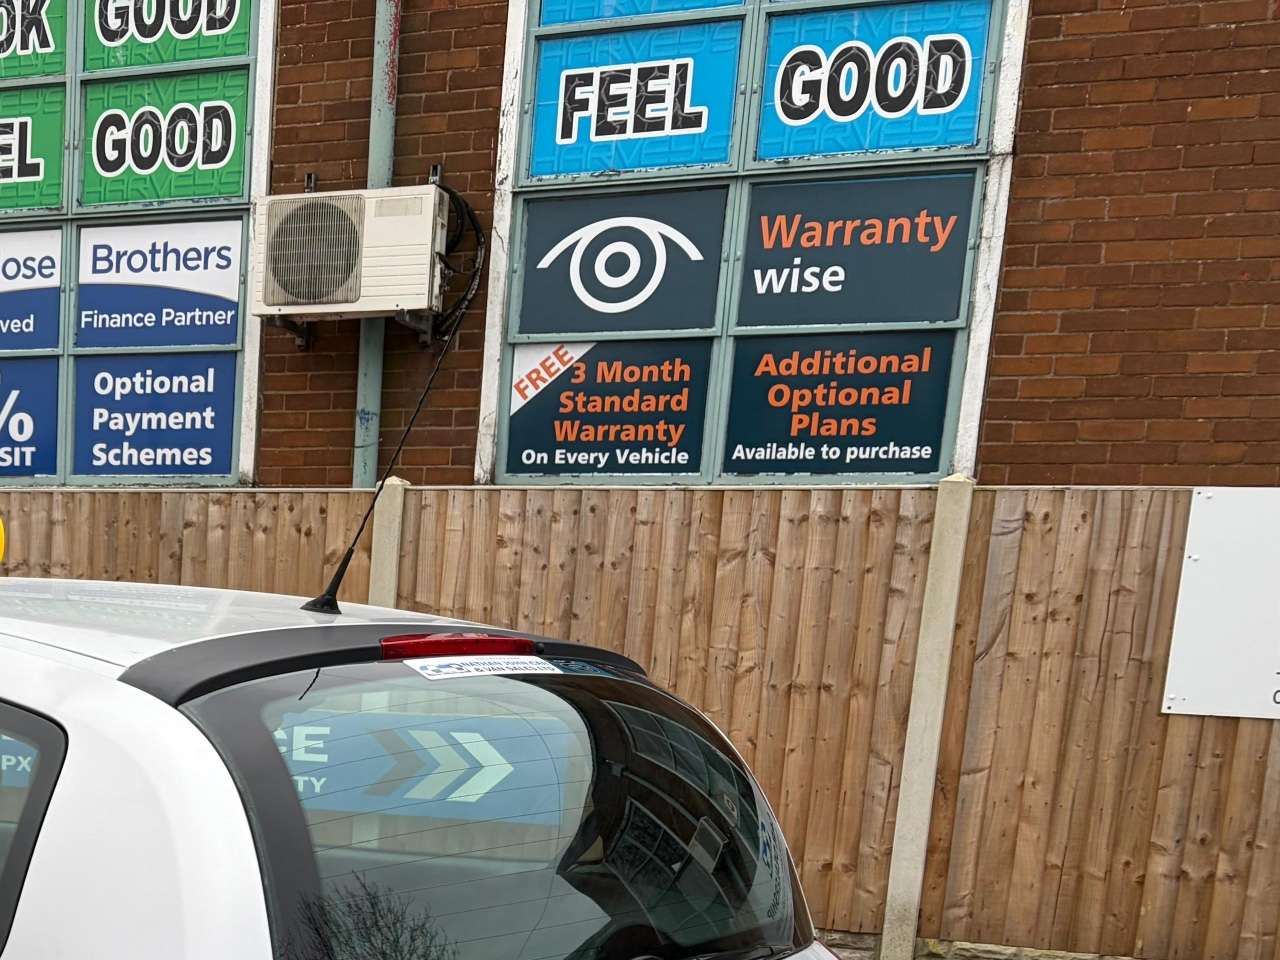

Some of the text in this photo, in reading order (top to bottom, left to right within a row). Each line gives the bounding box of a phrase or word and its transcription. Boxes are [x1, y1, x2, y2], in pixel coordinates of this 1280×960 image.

[95, 0, 238, 47] GOOD
[556, 33, 972, 144] FEEL GOOD
[93, 101, 236, 177] GOOD
[760, 208, 958, 253] Warranty
[91, 241, 232, 274] Brothers
[754, 257, 846, 294] wise
[80, 307, 235, 329] Finance Partner
[512, 343, 575, 401] FREE
[570, 358, 691, 384] 3 Month
[754, 347, 932, 377] Additional
[94, 368, 215, 401] Optional
[767, 380, 912, 412] Optional
[558, 388, 689, 415] Standard
[92, 406, 216, 437] Payment
[553, 419, 685, 449] Warranty
[790, 412, 877, 437] Plans
[91, 442, 213, 467] Schemes
[521, 447, 689, 468] On Every Vehicle
[732, 442, 933, 465] Available to purchase
[1, 754, 31, 772] PX
